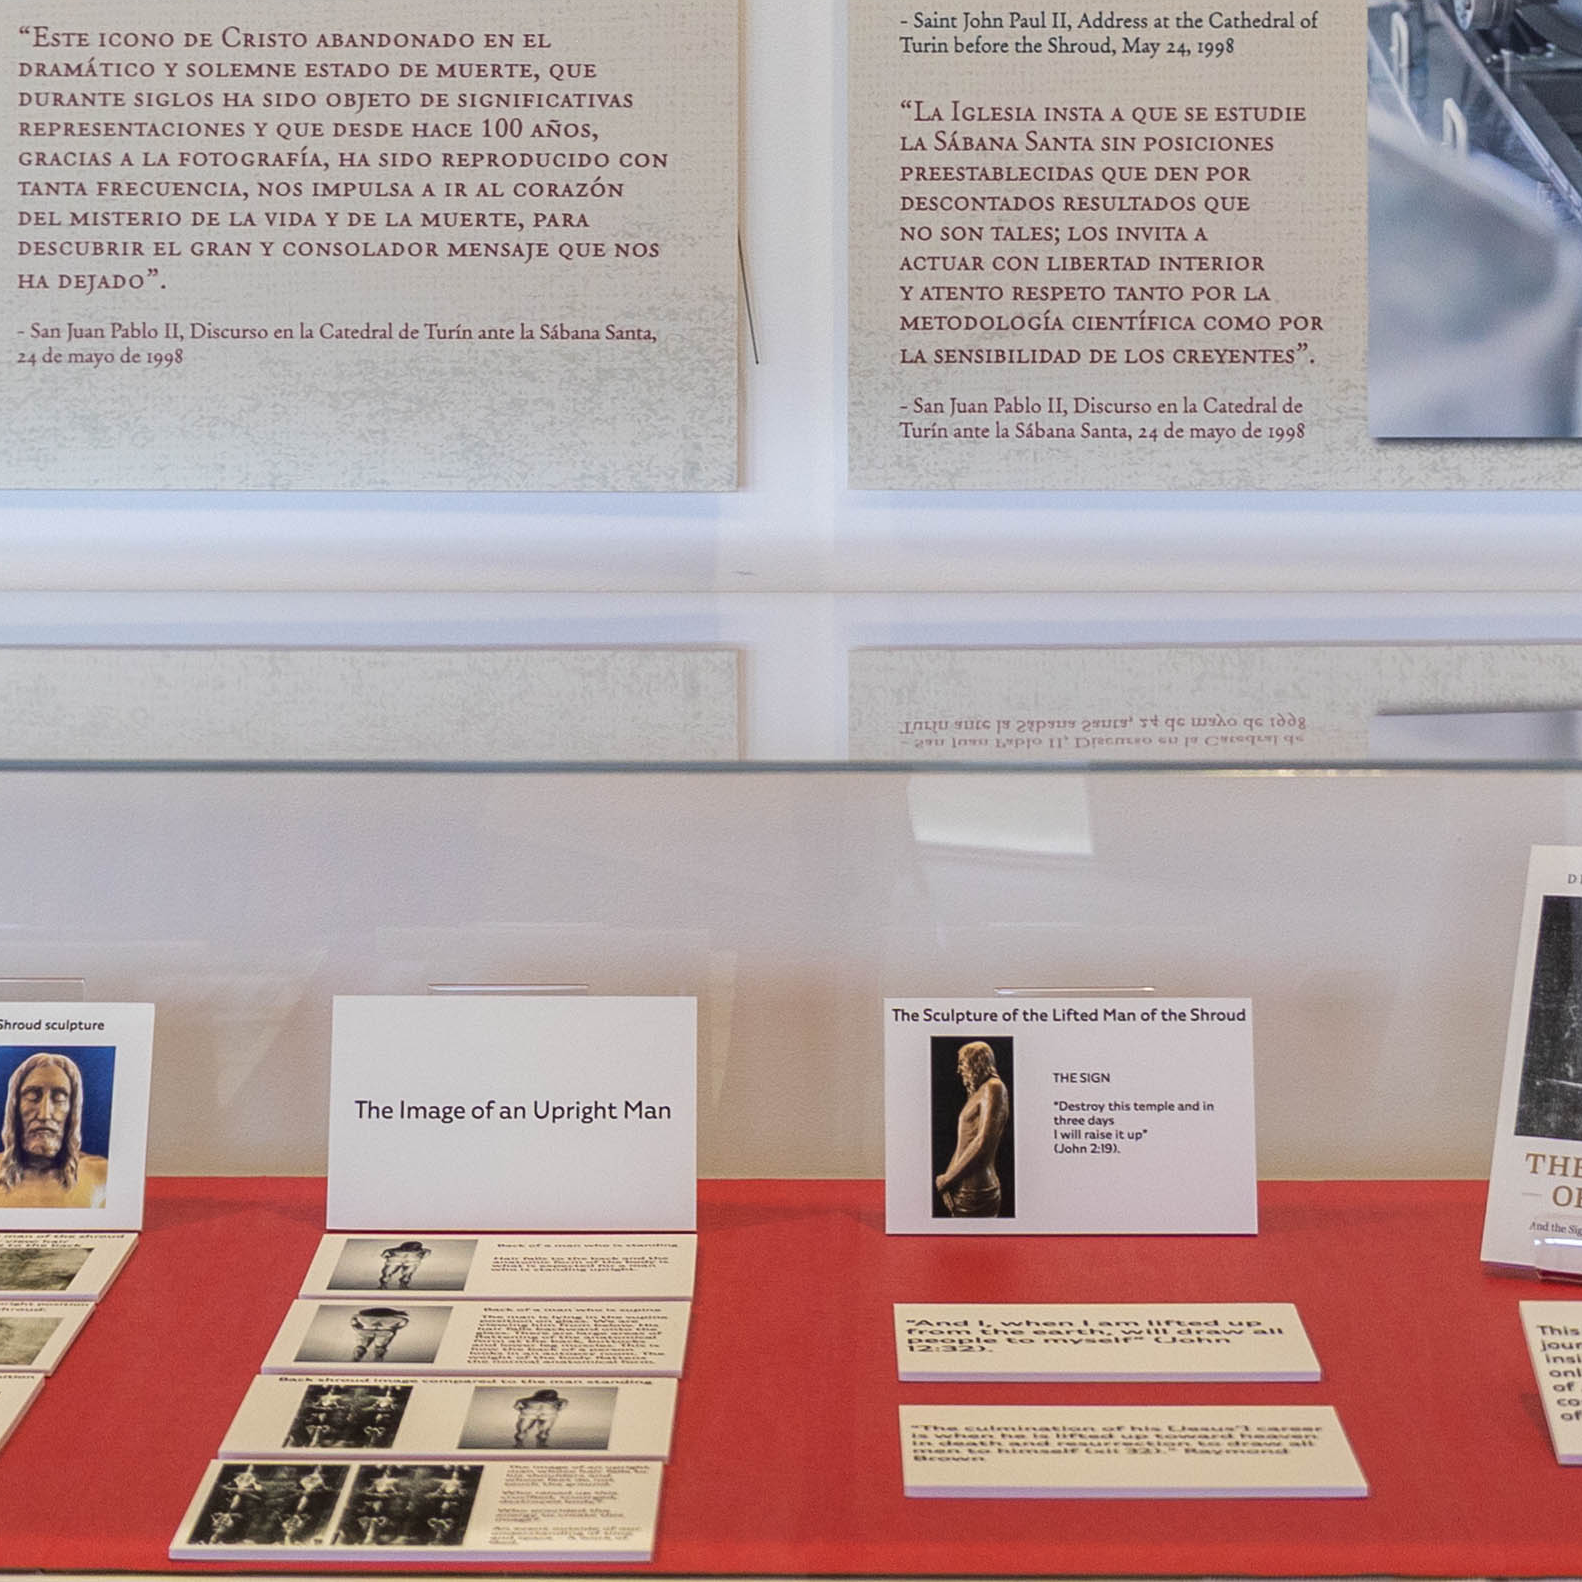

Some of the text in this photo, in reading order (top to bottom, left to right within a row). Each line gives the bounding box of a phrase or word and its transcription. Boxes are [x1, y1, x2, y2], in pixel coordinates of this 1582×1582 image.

[899, 35, 1234, 58] Turin before the Shroud, May 24, 1998
[17, 346, 183, 368] 24 de mayo de 1998
[892, 1008, 1245, 1024] The Sculpture of the Lifted Man of the Shroud
[45, 1020, 104, 1032] sculpture
[1053, 1073, 1110, 1083] THE SIGN
[355, 1100, 670, 1123] The Image of an Upright Man
[1108, 1101, 1130, 1111] this
[1134, 1101, 1175, 1112] temple
[1178, 1101, 1199, 1111] and
[1203, 1102, 1214, 1110] in
[1054, 1116, 1114, 1127] three days
[1054, 1130, 1057, 1139] I
[1060, 1130, 1081, 1139] will
[1085, 1130, 1112, 1139] raise
[1116, 1130, 1124, 1139] it
[1054, 1143, 1120, 1153] (John 2:19).
[1529, 1221, 1549, 1231] And
[1551, 1222, 1566, 1233] the
[1537, 1326, 1580, 1335] This
